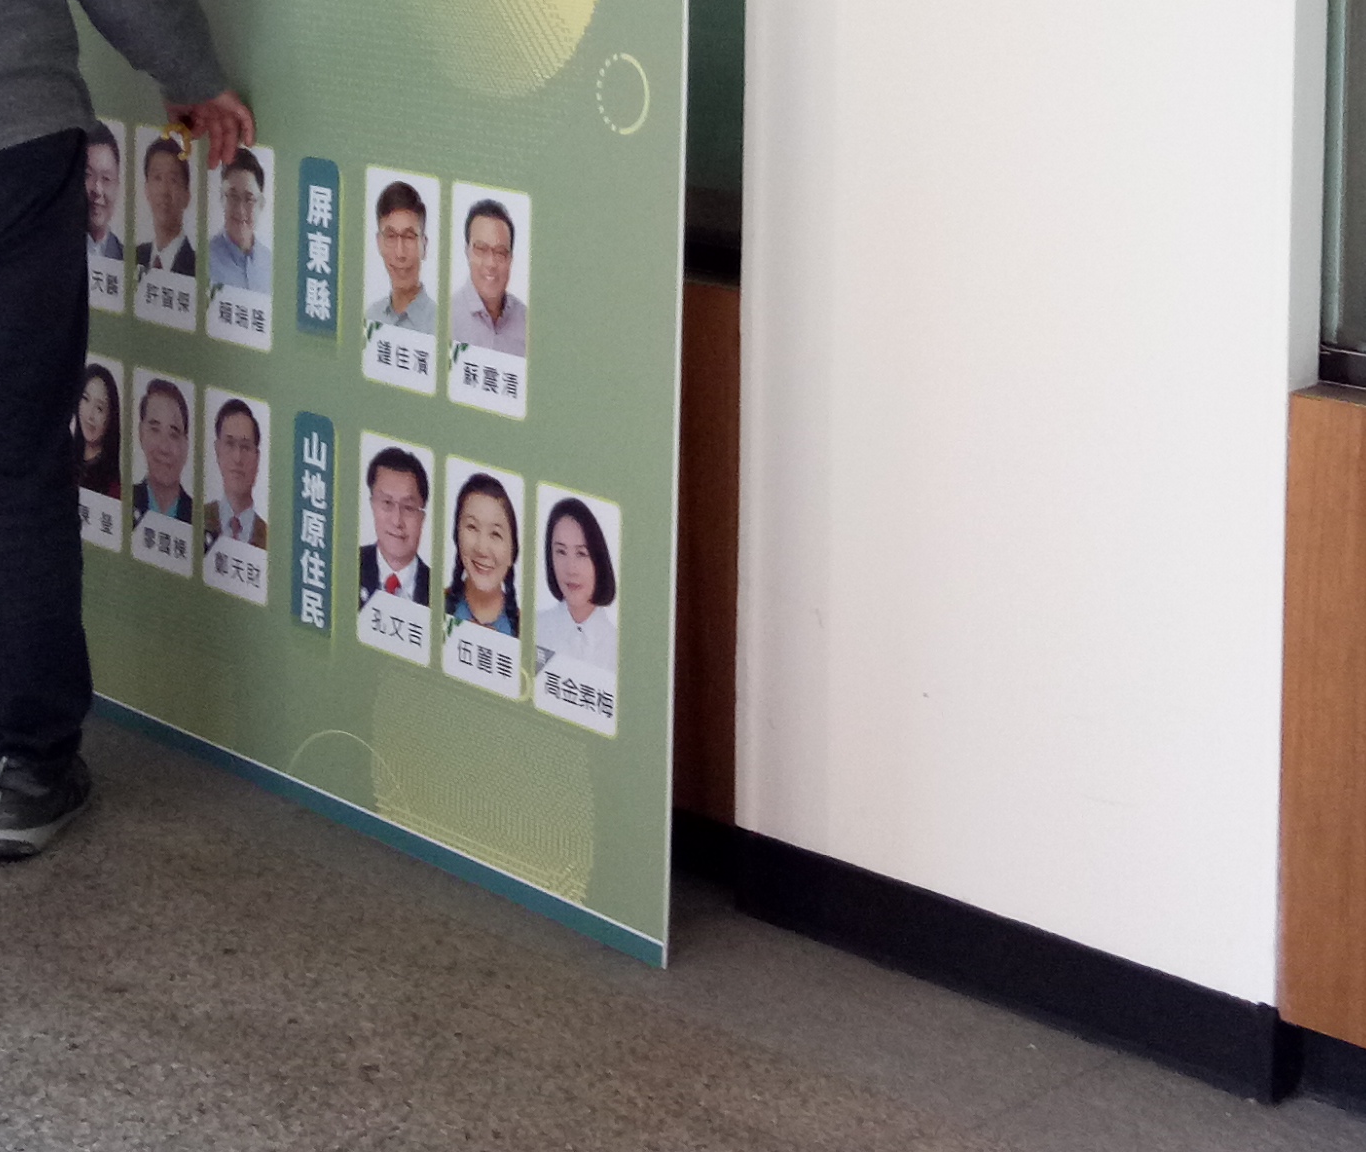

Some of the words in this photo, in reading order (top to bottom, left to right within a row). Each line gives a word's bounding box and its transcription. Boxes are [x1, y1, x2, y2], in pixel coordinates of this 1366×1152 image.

[304, 184, 333, 322] 屏東縣
[299, 431, 329, 629] 山地原住民
[370, 607, 423, 647] 孔文吉
